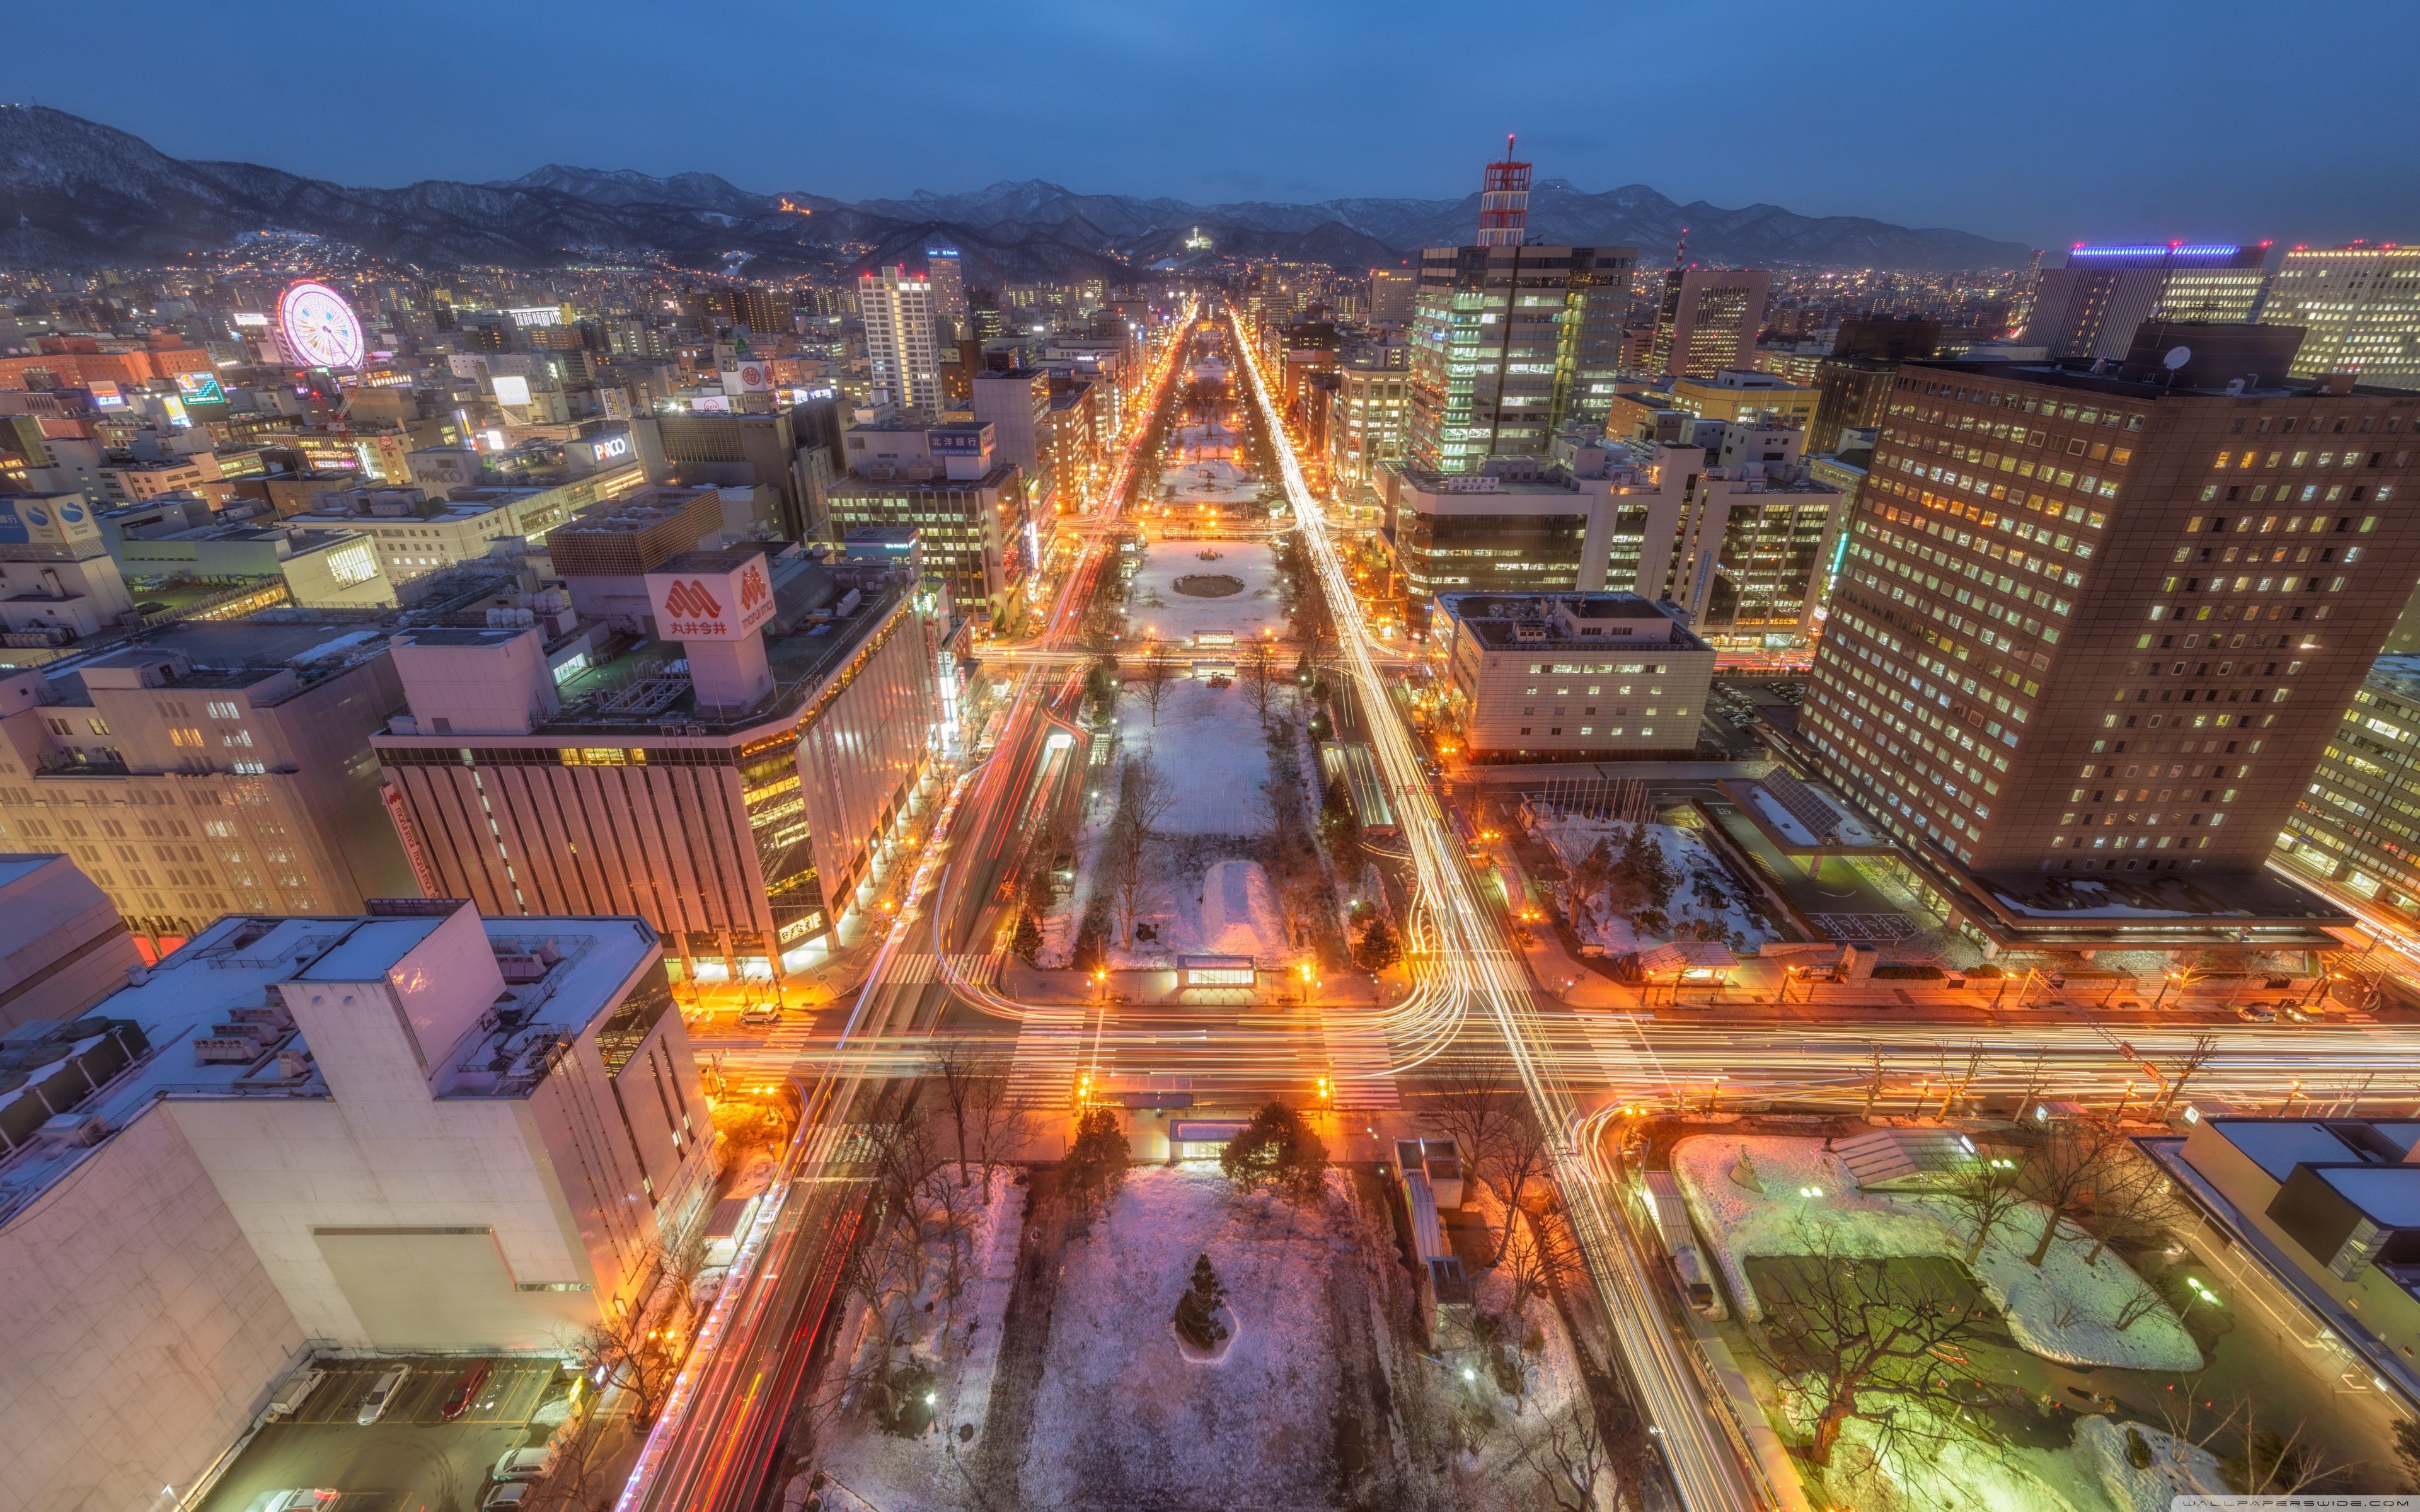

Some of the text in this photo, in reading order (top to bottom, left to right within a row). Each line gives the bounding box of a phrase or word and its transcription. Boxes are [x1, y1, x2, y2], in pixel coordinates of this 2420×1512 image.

[932, 437, 977, 447] 北洋銀行
[594, 438, 626, 461] PARCO
[417, 469, 464, 484] PARCO
[70, 523, 89, 531] SHINSEI
[670, 621, 727, 635] 丸井今井
[396, 807, 432, 891] marui imai marui imai
